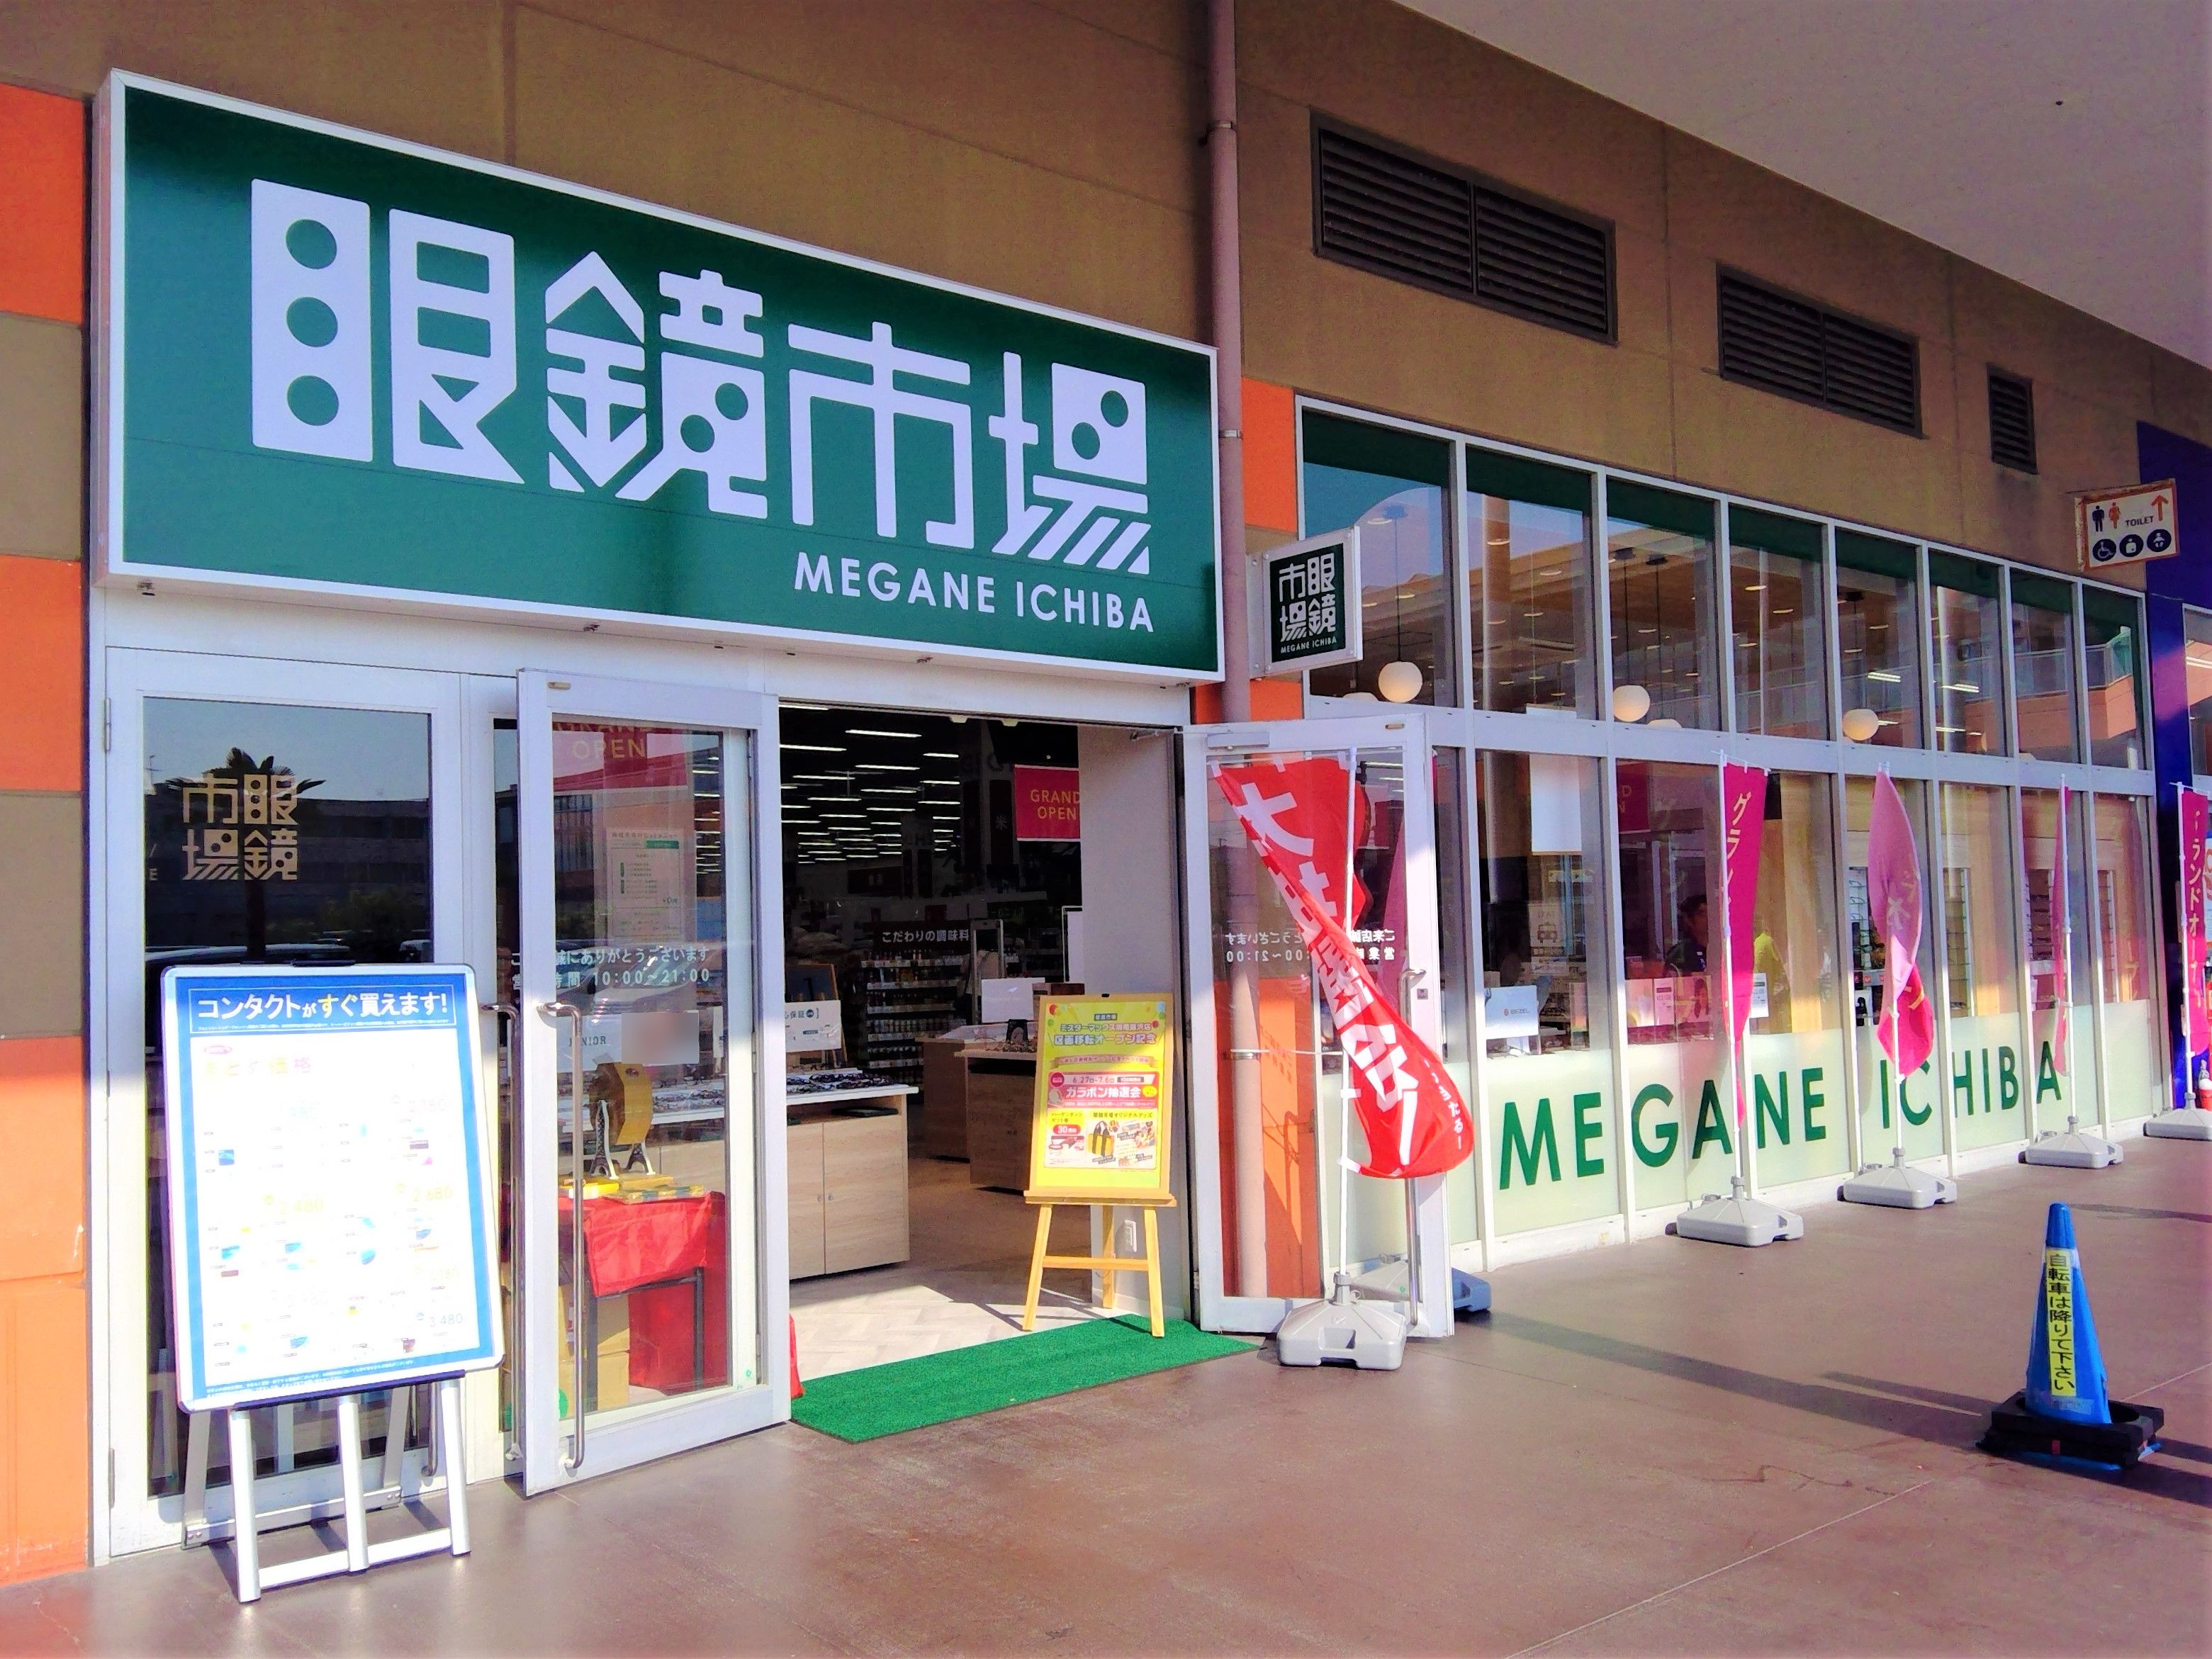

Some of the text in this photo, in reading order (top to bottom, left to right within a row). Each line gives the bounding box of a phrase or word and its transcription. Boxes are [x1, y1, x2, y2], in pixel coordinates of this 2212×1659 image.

[251, 178, 1151, 575] 眼鏡市場
[2125, 516, 2155, 527] TOILET
[794, 551, 1154, 633] MEGANE ICHIBA
[1280, 636, 1337, 654] MEGANE ICHIBA
[571, 738, 646, 760] OPEN
[1030, 789, 1080, 804] GRAND
[1037, 806, 1077, 821] OPEN
[197, 991, 448, 1020] コンタクトがすぐ買えます!
[568, 1035, 607, 1047] JNIOR
[1499, 1040, 2062, 1191] MEGANE ICHIBA
[2048, 1253, 2075, 1391] 自転車は降りて下さい
